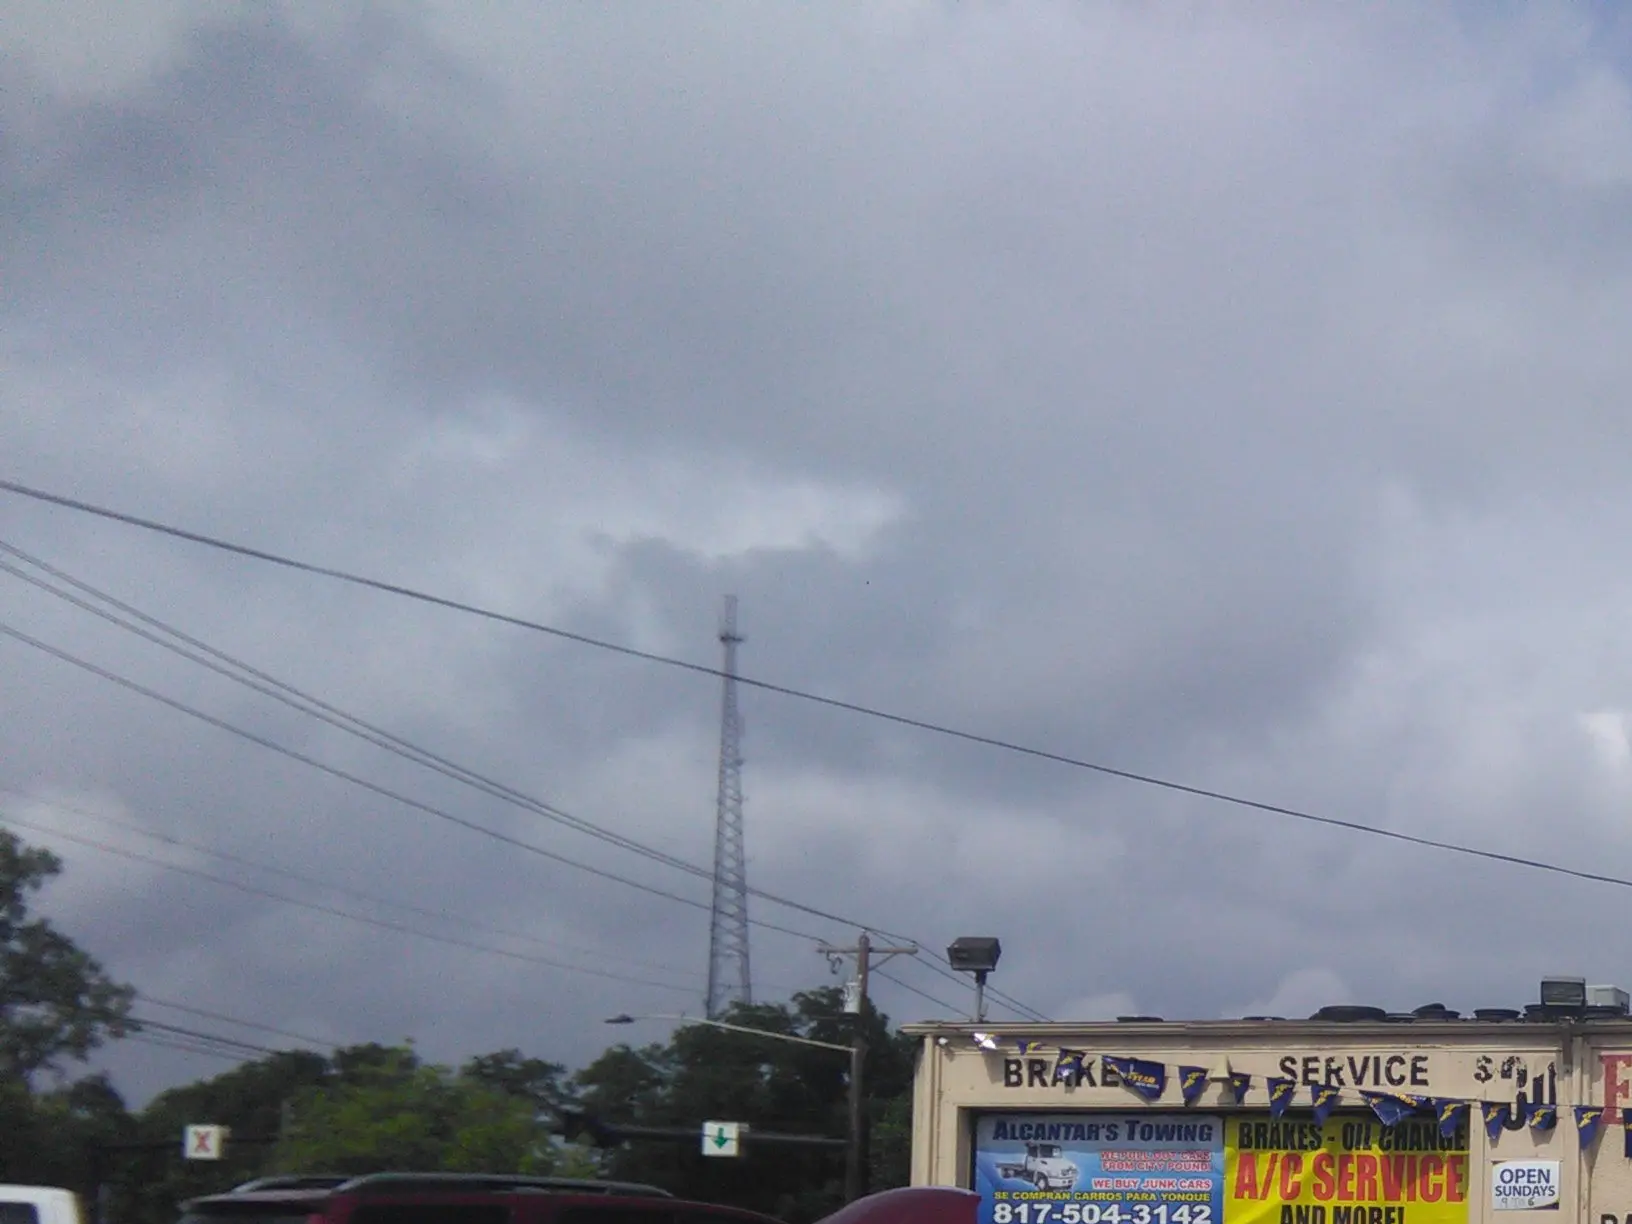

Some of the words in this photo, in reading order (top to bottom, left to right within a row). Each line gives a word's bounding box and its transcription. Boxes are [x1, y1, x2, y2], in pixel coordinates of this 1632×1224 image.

[1279, 1055, 1429, 1087] SERVICE
[1125, 1119, 1213, 1142] TOWING
[1239, 1122, 1322, 1151] BRAKES
[1342, 1122, 1372, 1151] OIL
[1094, 1179, 1112, 1189] WE
[1115, 1179, 1138, 1189] BUY
[1142, 1179, 1176, 1189] JUNK
[1179, 1179, 1210, 1189] CARS
[1235, 1153, 1303, 1201] A/C
[1313, 1152, 1464, 1203] SERVICE
[1500, 1168, 1550, 1185] OPEN
[1013, 1191, 1070, 1200] COMPRAN
[1074, 1192, 1122, 1201] CARROS
[1126, 1193, 1156, 1201] PARA
[1161, 1193, 1210, 1201] YONQUE
[1495, 1185, 1556, 1197] SUNDAYS
